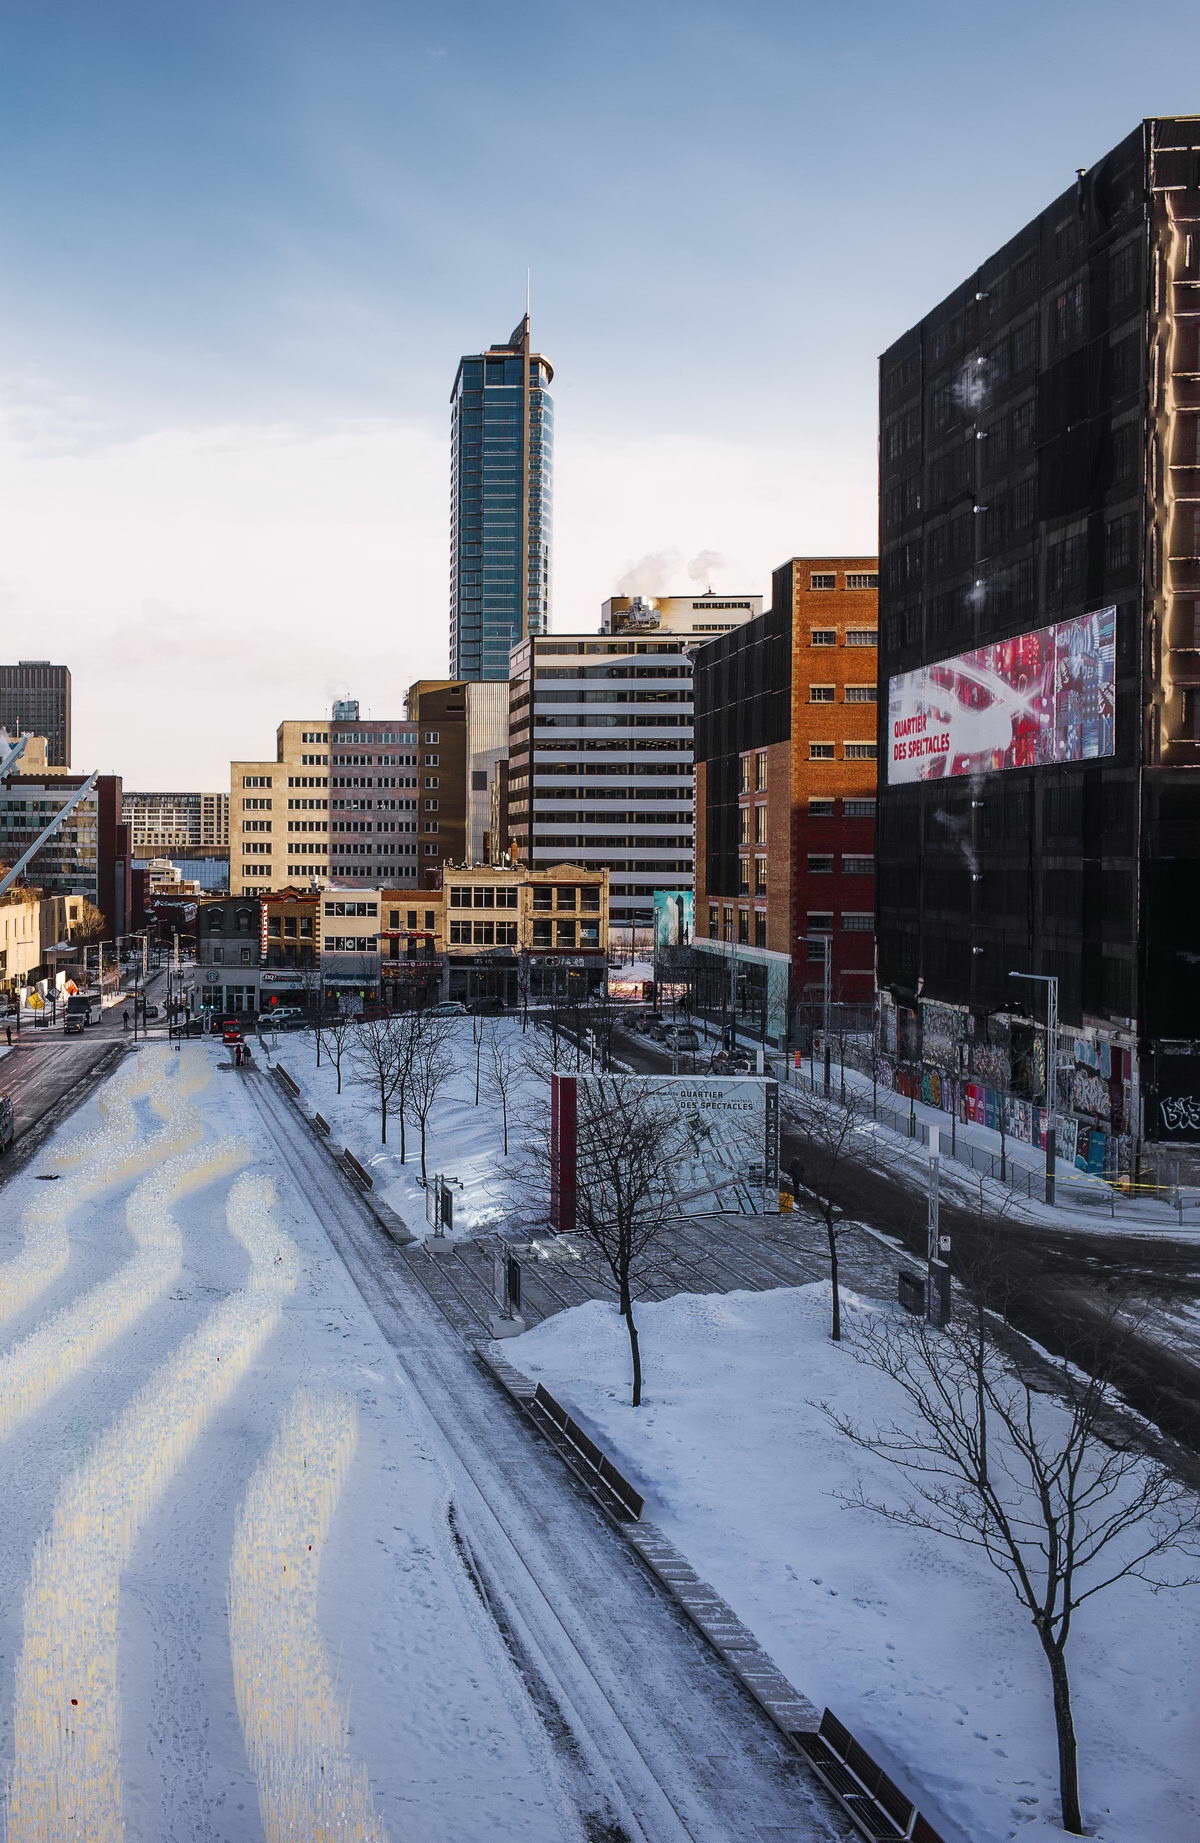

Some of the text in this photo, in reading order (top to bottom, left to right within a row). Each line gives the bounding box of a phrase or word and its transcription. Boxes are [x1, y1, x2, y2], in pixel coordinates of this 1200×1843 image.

[894, 713, 928, 738] QUARTIER
[893, 732, 950, 761] DES SPECTACLES
[680, 1090, 724, 1099] QUARTIER
[680, 1101, 753, 1110] DES SPECTACLES
[769, 1099, 774, 1109] 1
[769, 1123, 776, 1133] 2
[768, 1146, 775, 1156] 3
[768, 1169, 775, 1179] 4
